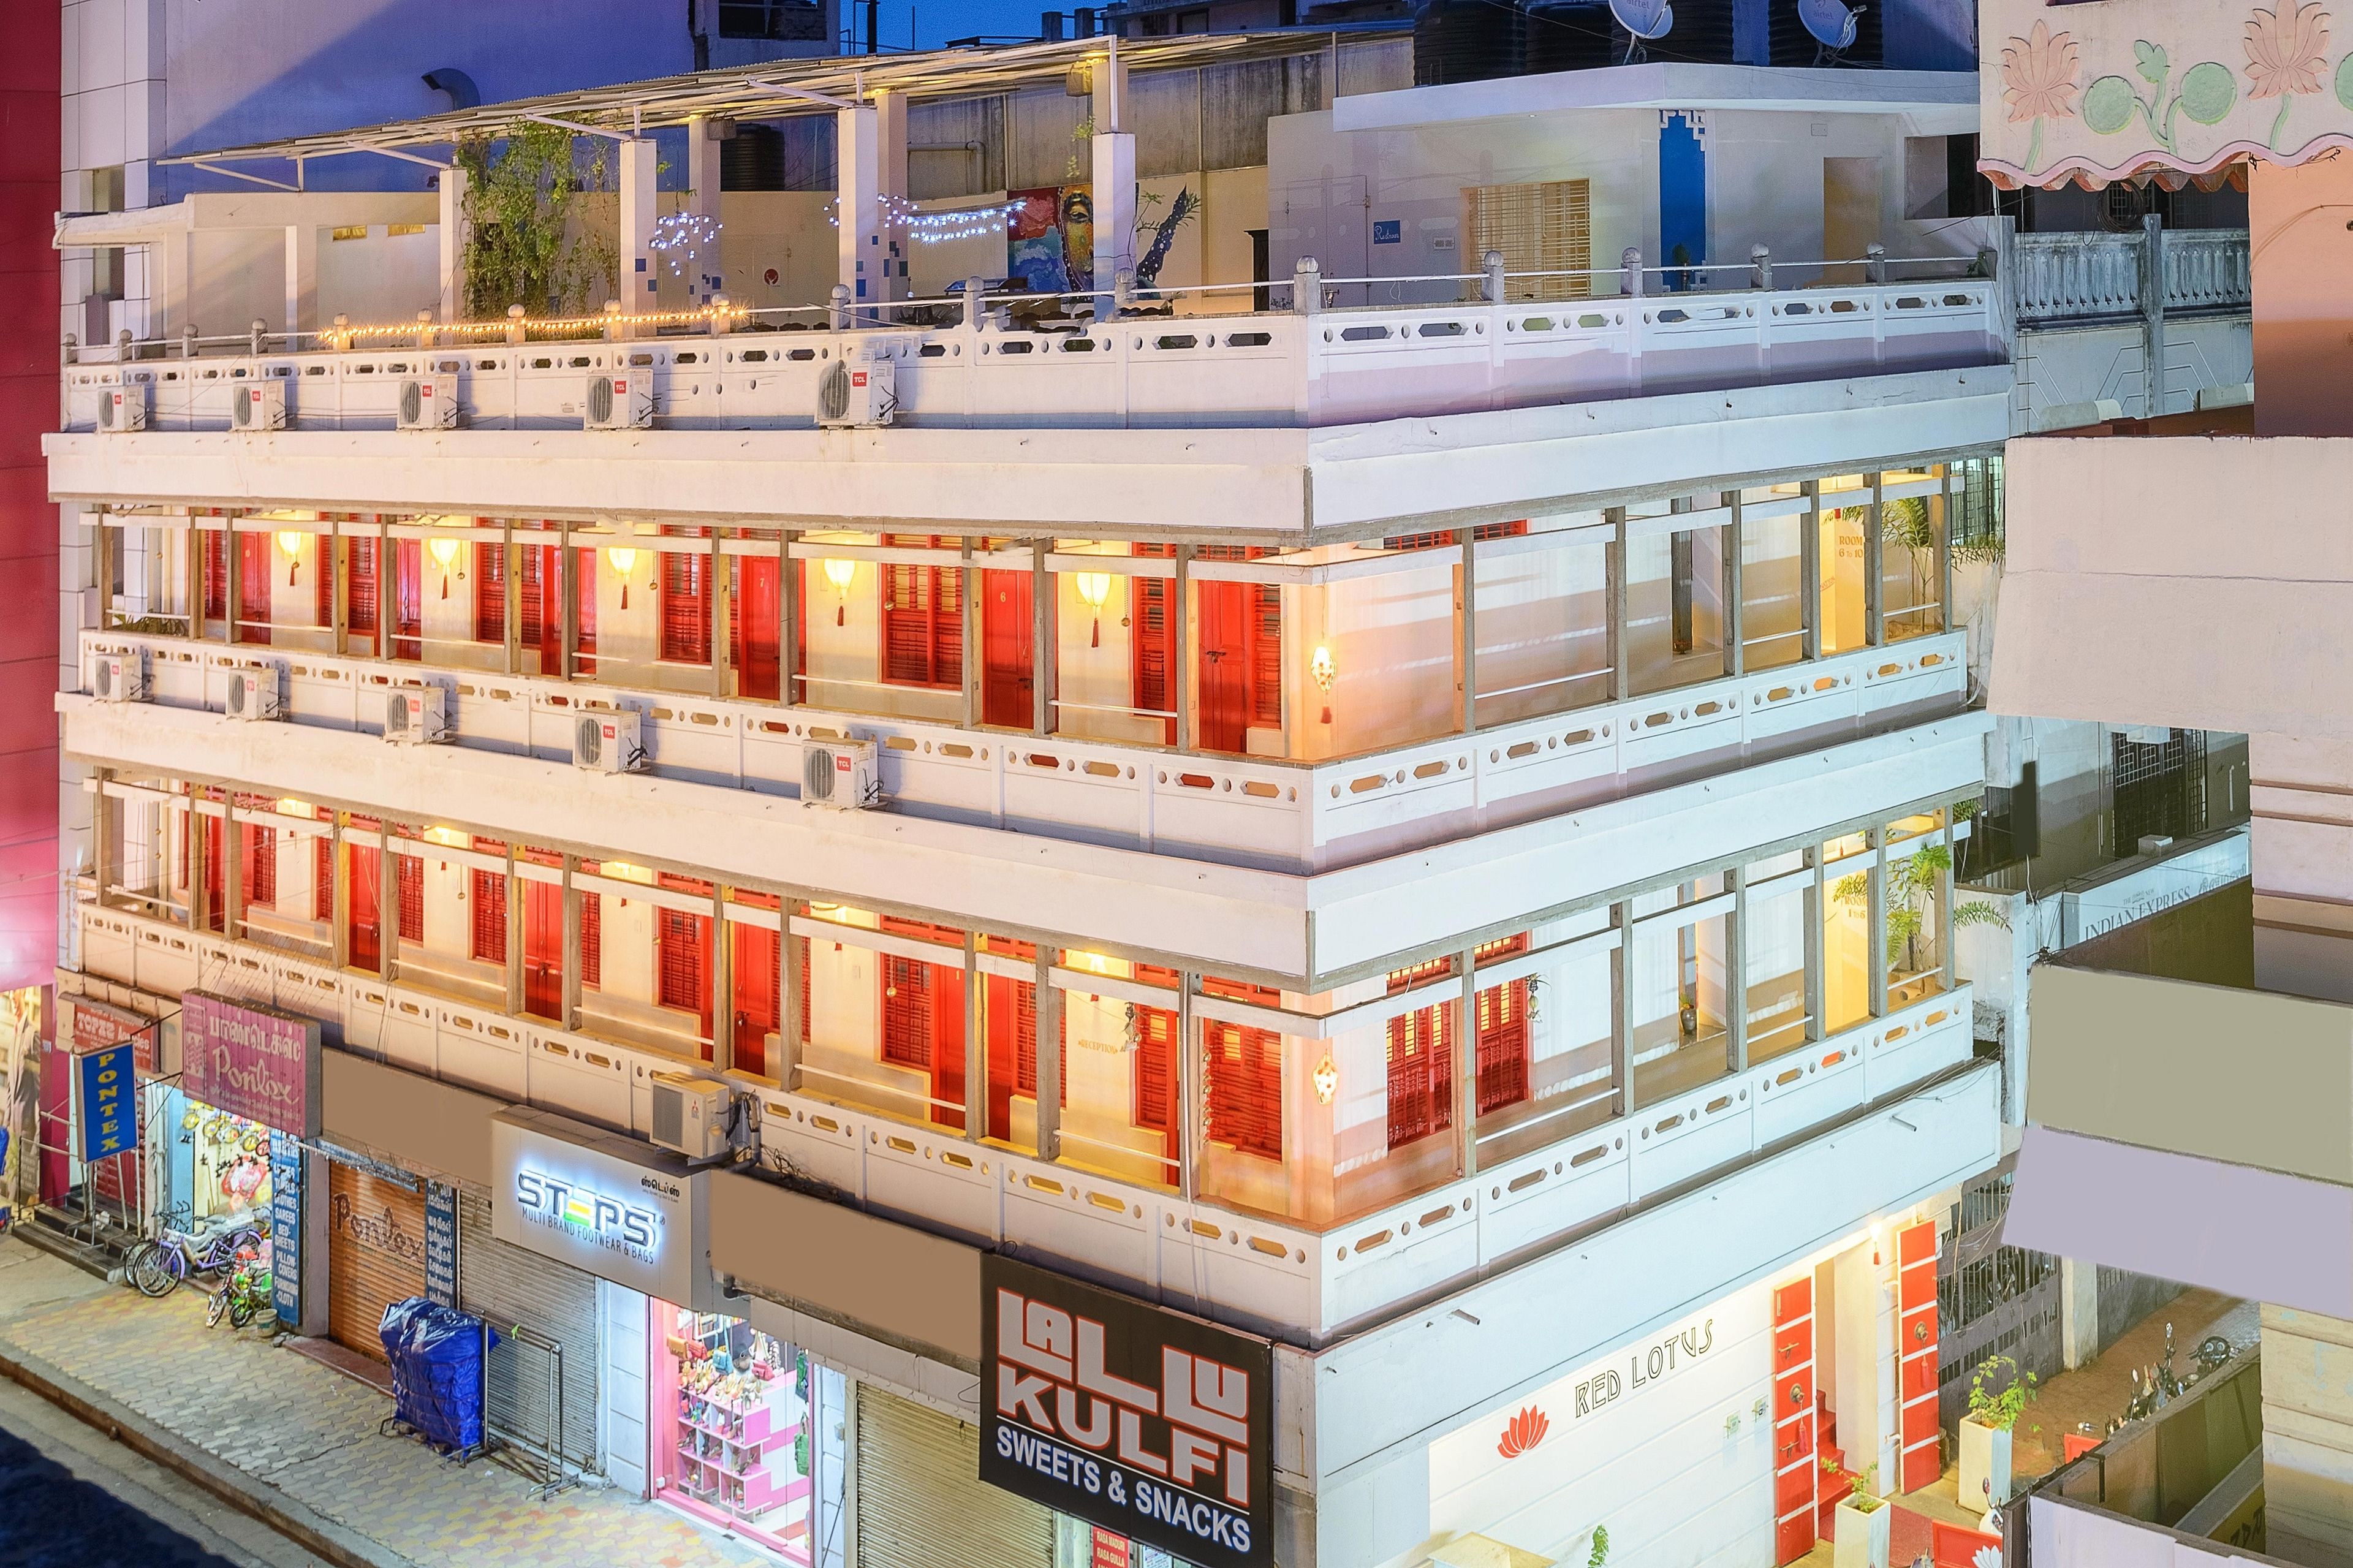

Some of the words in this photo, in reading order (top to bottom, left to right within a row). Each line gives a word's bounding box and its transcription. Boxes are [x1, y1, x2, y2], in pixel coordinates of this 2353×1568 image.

[1839, 536, 1863, 545] ROOM
[1839, 548, 1844, 557] 6
[1854, 549, 1863, 558] 10
[1000, 591, 1006, 602] 6
[2085, 906, 2135, 941] INDIAN
[2139, 885, 2191, 920] EXPRESS
[1080, 1039, 1115, 1054] RECEPTION
[97, 1052, 121, 1153] PONTEX
[641, 1175, 680, 1197] ஸ்டெப்ஸ்
[275, 1207, 295, 1224] SAREES
[518, 1169, 656, 1249] STEPS
[275, 1234, 295, 1252] SHEETS
[522, 1206, 545, 1226] MULTI
[548, 1215, 575, 1236] BRAND
[577, 1225, 621, 1253] FOOTWEAR
[624, 1242, 629, 1256] &
[632, 1245, 654, 1265] BAGS
[278, 1263, 297, 1281] COVERS
[998, 1287, 1249, 1447] LALLU
[1575, 1370, 1621, 1418] RED
[1632, 1319, 1713, 1389] LOTUS
[998, 1360, 1249, 1507] KULFI
[996, 1425, 1101, 1495] SWEETS
[1107, 1470, 1127, 1506] &
[1135, 1480, 1251, 1553] SNACKS
[1097, 1531, 1108, 1544] RASA
[1097, 1547, 1110, 1562] RASA
[1110, 1552, 1125, 1568] GULLA
